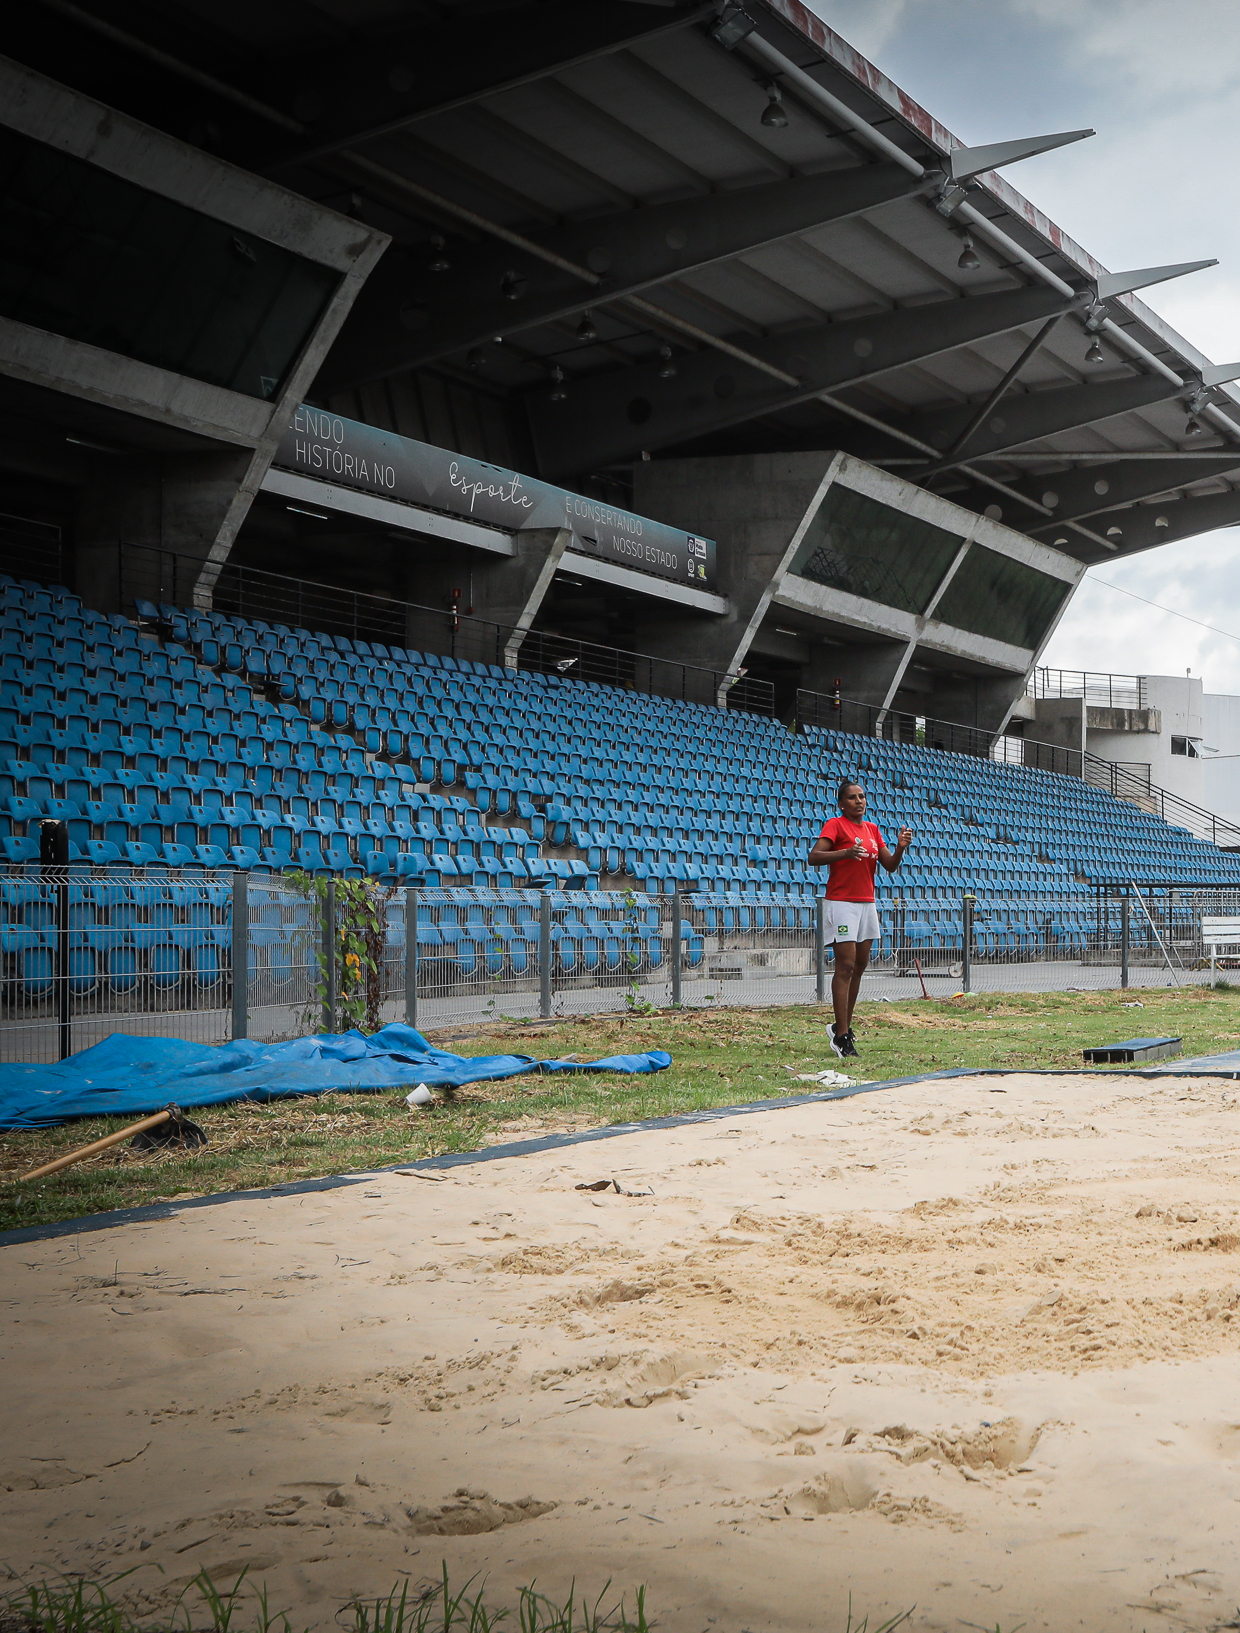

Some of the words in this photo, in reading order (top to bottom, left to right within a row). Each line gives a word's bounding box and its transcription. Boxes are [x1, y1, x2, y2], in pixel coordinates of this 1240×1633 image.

[289, 407, 344, 444] ENDO
[295, 439, 370, 482] HISTÓRIA
[374, 462, 395, 489] NO
[449, 461, 534, 513] Esporte
[565, 496, 572, 513] E
[574, 499, 643, 536] CONSERTANDO
[613, 535, 643, 559] NOSSO
[645, 545, 678, 570] ESTADO
